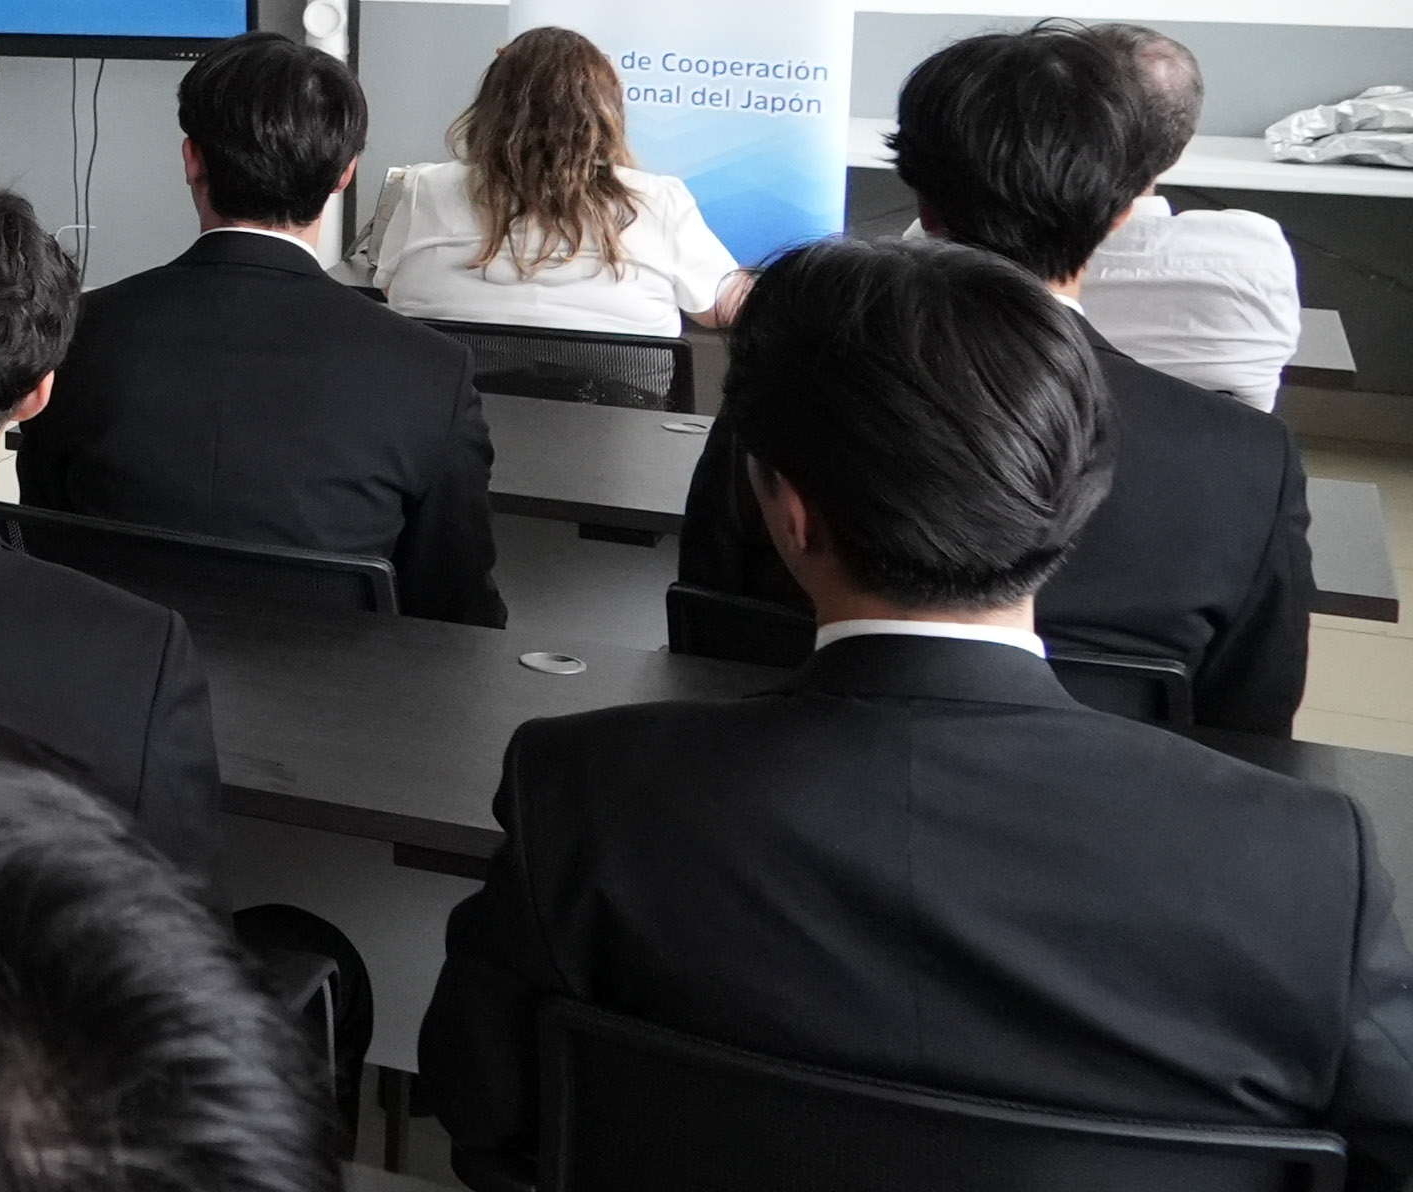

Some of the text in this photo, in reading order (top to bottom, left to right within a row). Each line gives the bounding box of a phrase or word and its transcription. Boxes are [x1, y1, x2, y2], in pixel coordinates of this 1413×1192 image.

[620, 51, 652, 71] de
[661, 52, 829, 82] Cooperación
[690, 87, 731, 108] del
[739, 89, 823, 115] Japón
